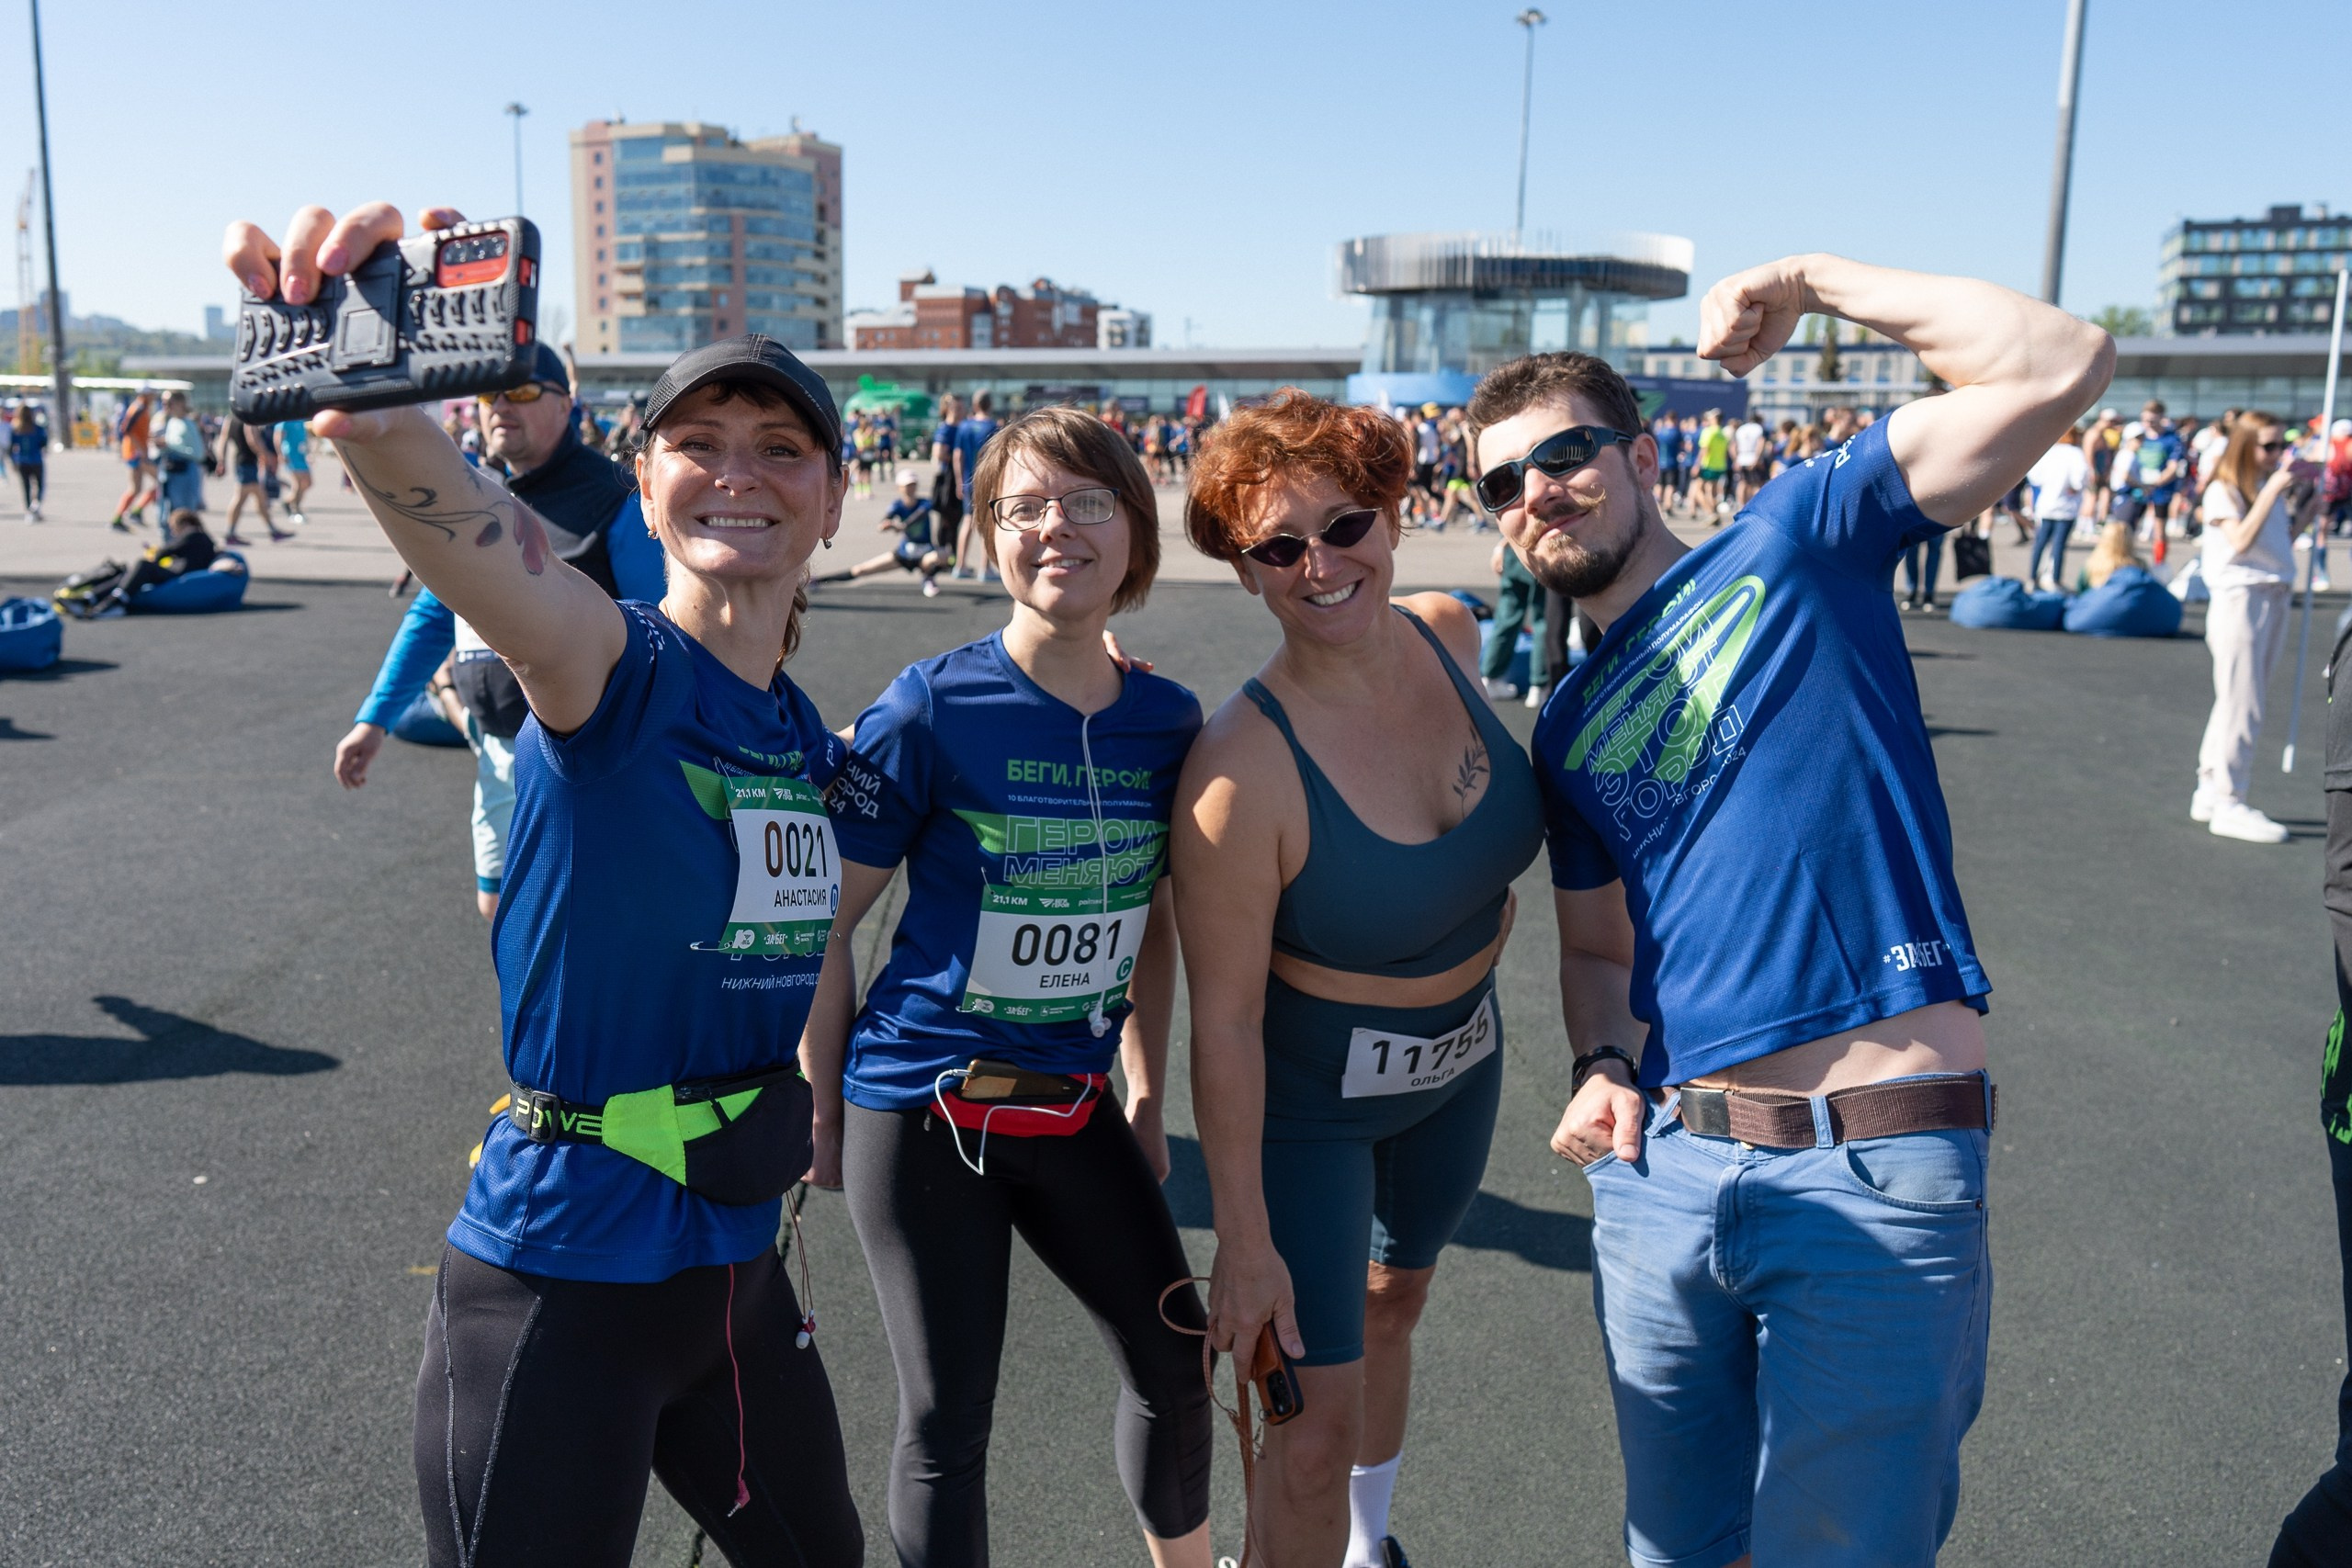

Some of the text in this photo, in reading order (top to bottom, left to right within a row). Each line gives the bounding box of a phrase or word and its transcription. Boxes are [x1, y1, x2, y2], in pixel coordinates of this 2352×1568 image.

[1651, 599, 1704, 649] ПОЛУМАРАФОН
[1586, 638, 1718, 775] МЕНЯЮТ
[1595, 663, 1729, 807] ЭТОТ
[1007, 759, 1072, 788] БЕГИ,
[1612, 705, 1745, 841] ГОРОД
[735, 788, 752, 799] 21,1
[764, 820, 828, 877] 0021
[1006, 815, 1158, 856] ГЕРОИ
[1003, 855, 1155, 885] МЕНЯЮТ
[774, 888, 827, 908] АНАСТАСИЯ
[993, 895, 1009, 905] 21,1
[1012, 919, 1123, 966] 0081
[721, 976, 775, 990] НИЖНИЙ
[775, 973, 815, 988] НОВГОРОД
[1039, 972, 1091, 988] ЕЛЕНА
[1372, 1005, 1488, 1075] 11755
[1410, 1066, 1455, 1087] ОЛЬГА
